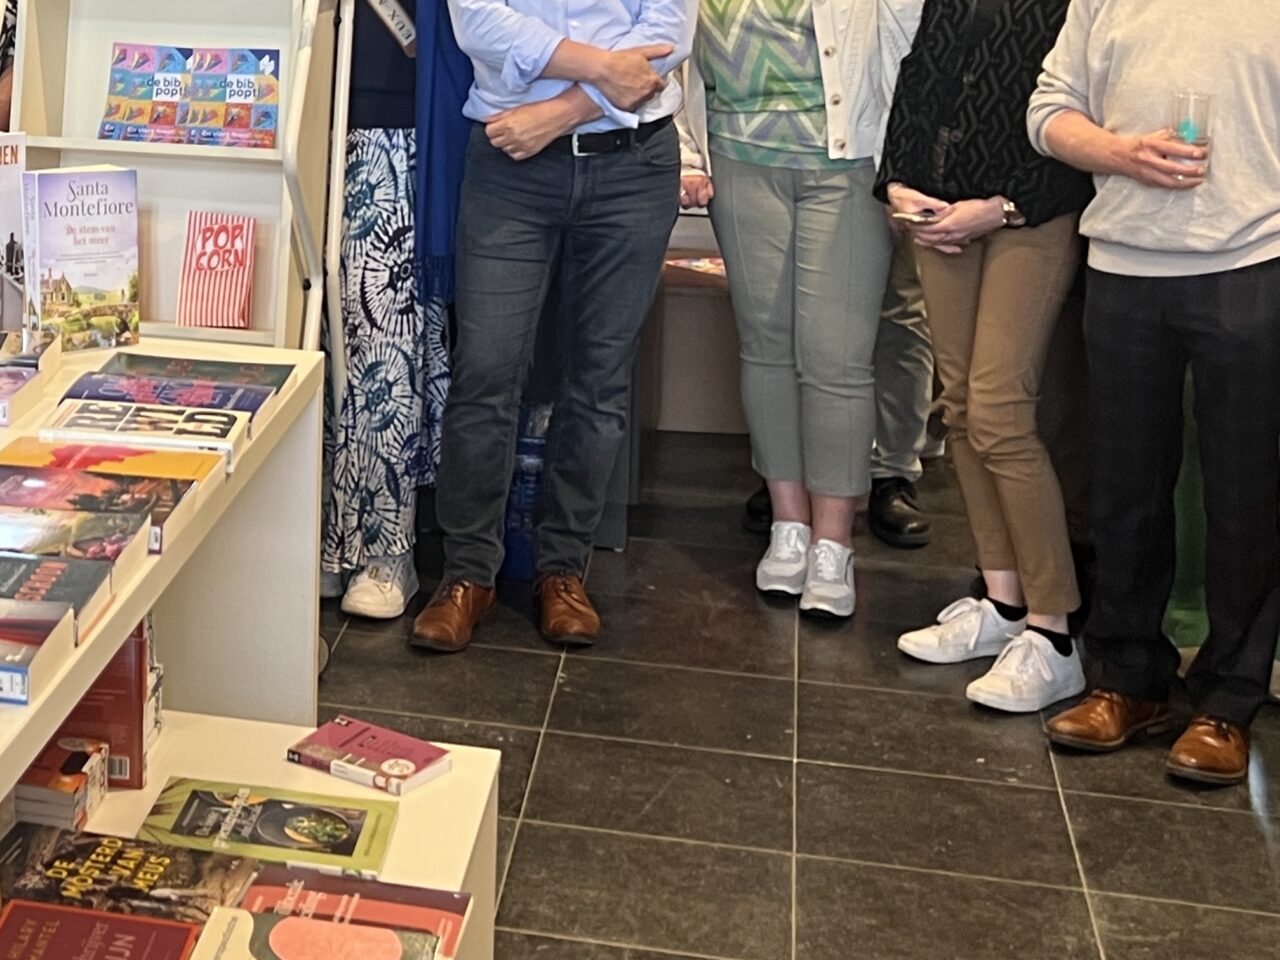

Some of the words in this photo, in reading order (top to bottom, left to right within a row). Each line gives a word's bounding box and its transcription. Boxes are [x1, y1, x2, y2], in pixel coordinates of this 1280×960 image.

[146, 77, 159, 87] de
[163, 77, 181, 87] bib
[220, 78, 233, 88] de
[236, 79, 254, 89] bib
[67, 179, 109, 202] Santa
[42, 199, 135, 218] Montefiore
[65, 224, 78, 235] De
[199, 223, 245, 250] POP
[195, 247, 247, 272] CORN
[46, 859, 76, 880] DE
[60, 837, 123, 900] MOSTERD
[108, 847, 146, 878] VAN
[133, 854, 172, 893] MEUS
